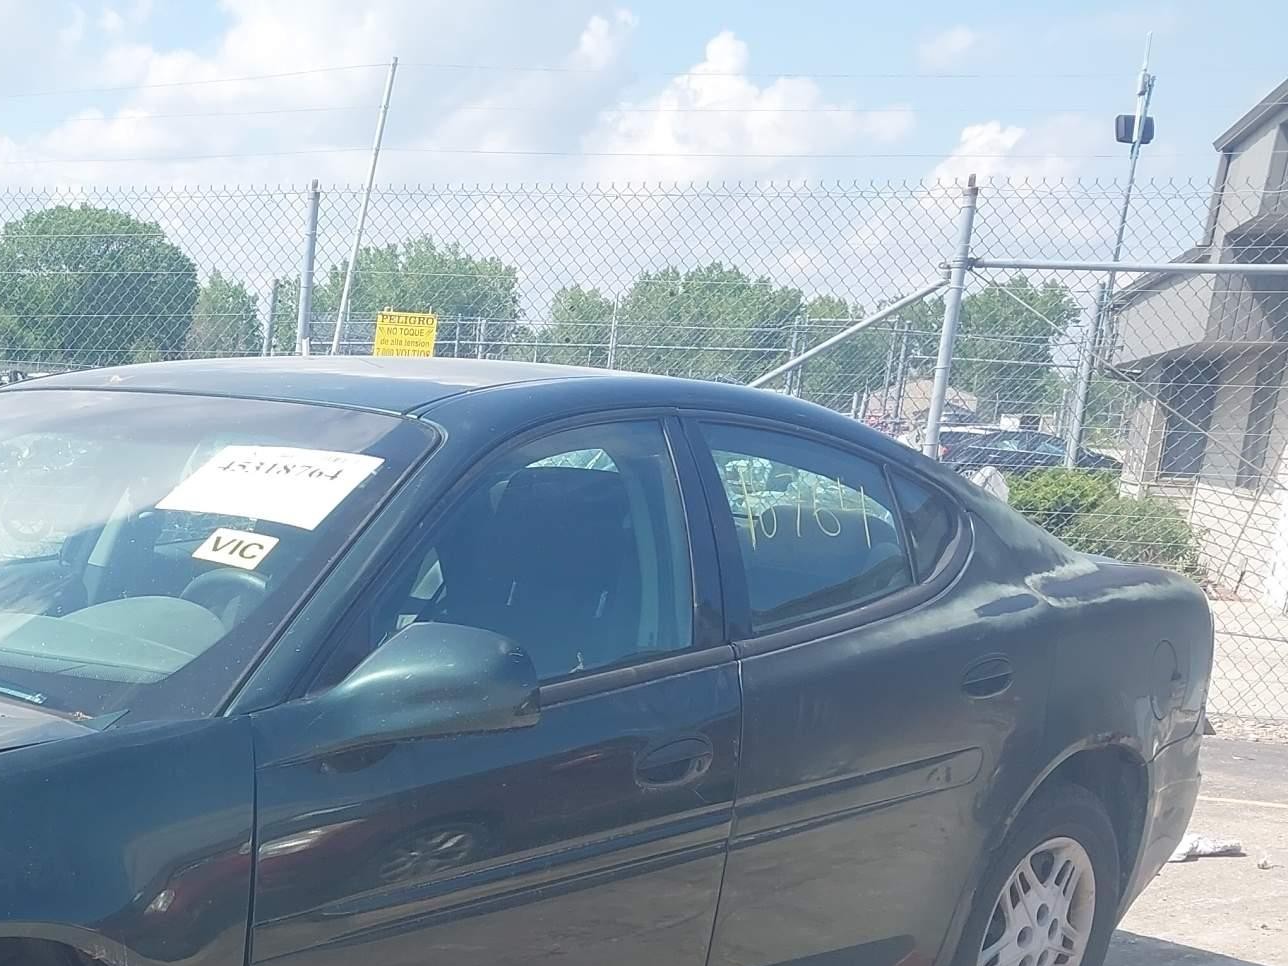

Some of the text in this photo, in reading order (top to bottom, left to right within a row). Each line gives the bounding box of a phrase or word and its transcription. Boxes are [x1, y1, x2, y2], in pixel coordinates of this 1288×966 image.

[381, 314, 435, 326] PELIGRO
[386, 326, 425, 337] NO TOQUE
[217, 460, 345, 481] 45318764
[211, 535, 265, 560] VIC
